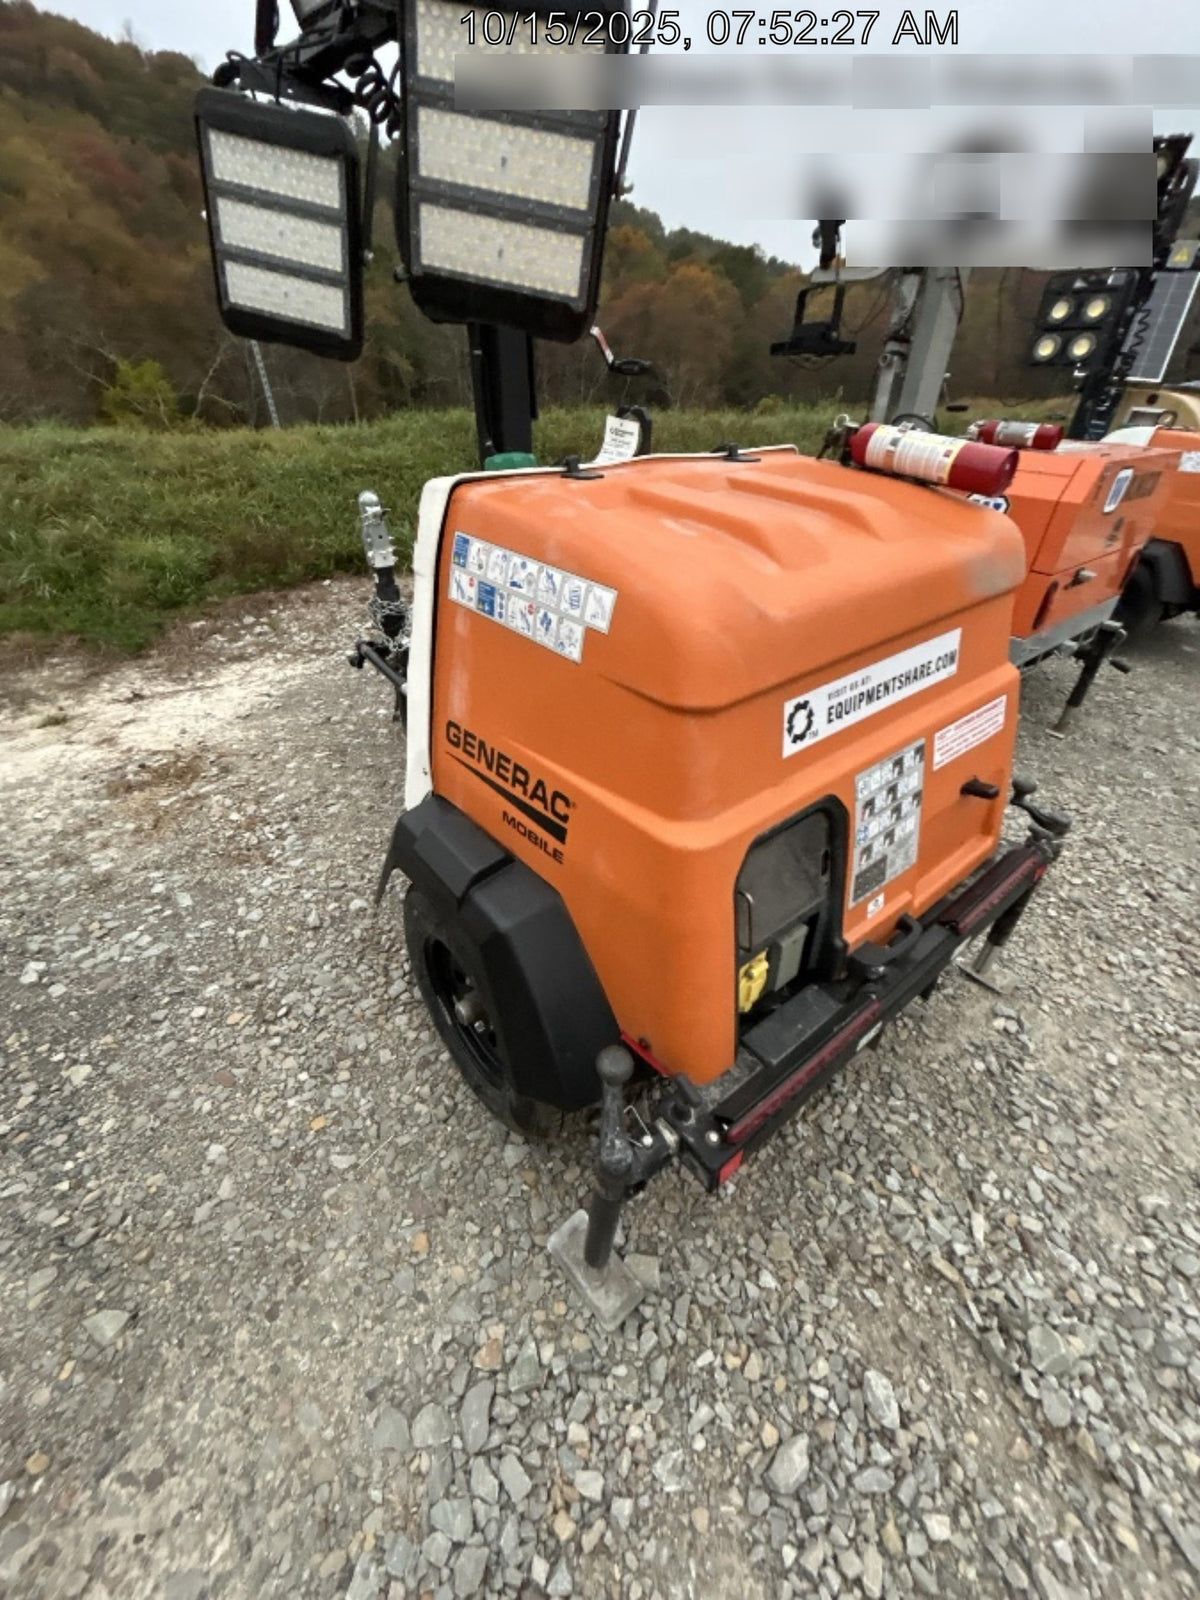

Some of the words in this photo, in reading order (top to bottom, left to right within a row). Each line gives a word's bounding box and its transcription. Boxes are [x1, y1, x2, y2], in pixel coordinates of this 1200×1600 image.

[827, 649, 957, 724] EQUIPMENTSHARE.COM
[445, 720, 571, 824] GENERAC
[502, 811, 564, 865] MOBILE
